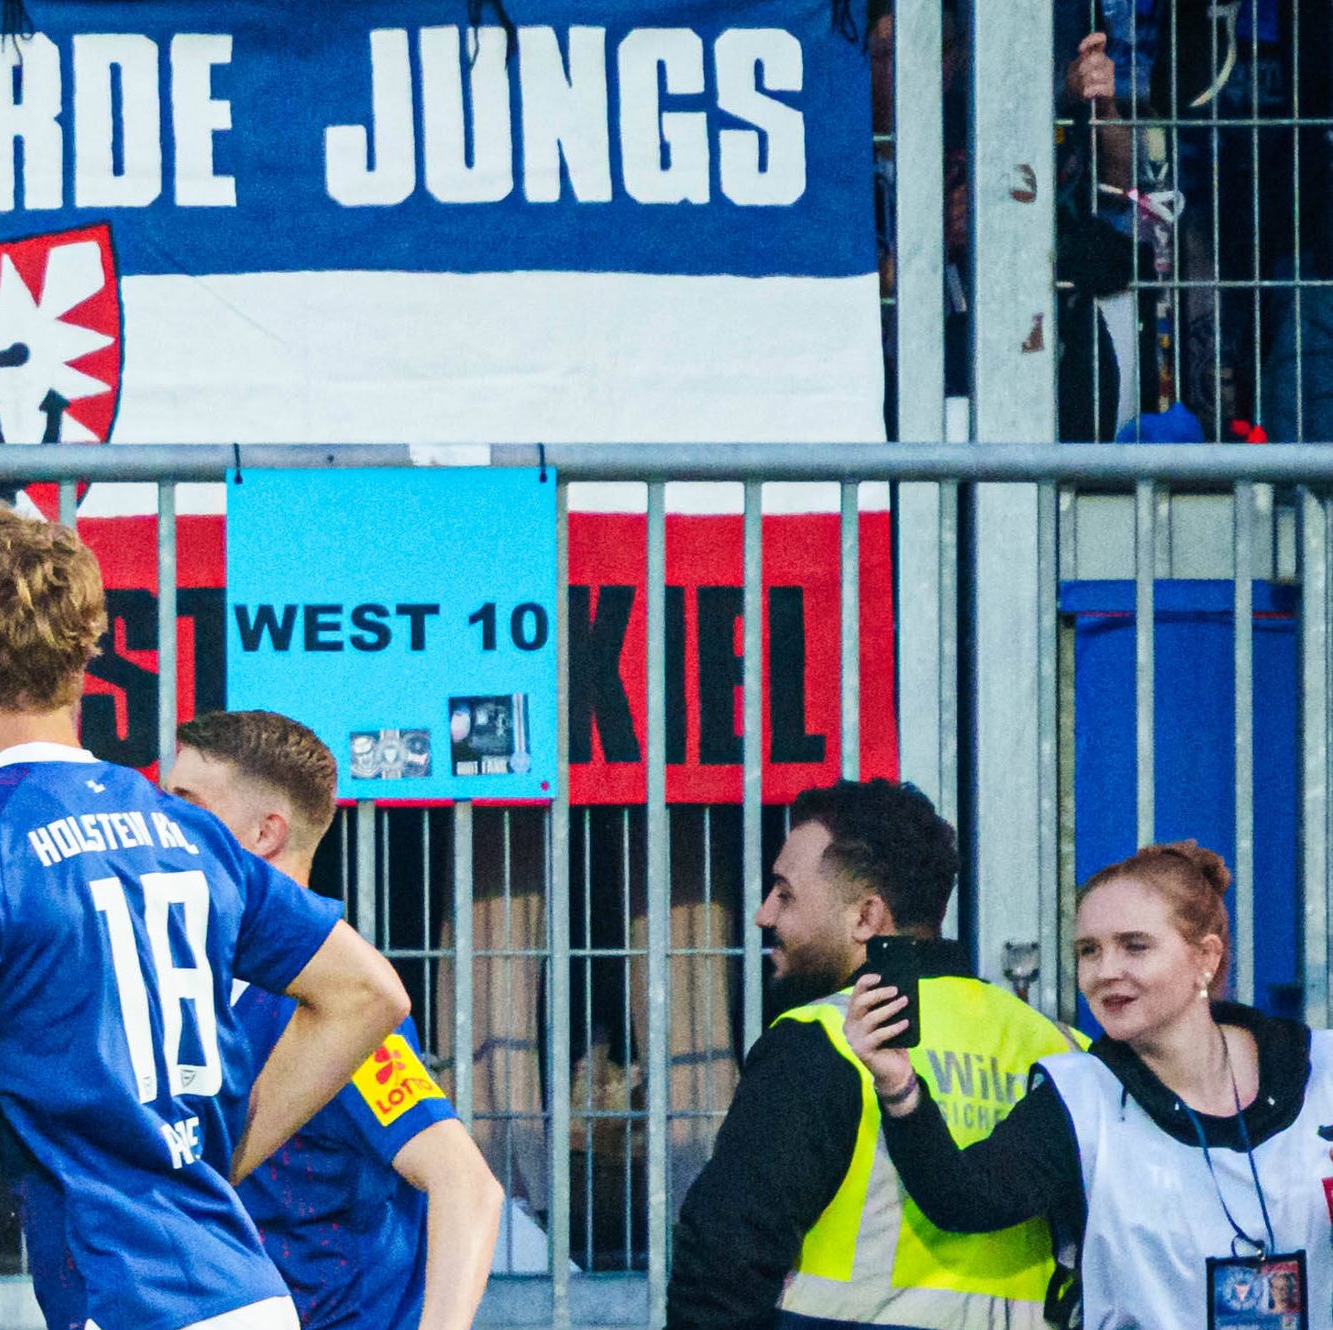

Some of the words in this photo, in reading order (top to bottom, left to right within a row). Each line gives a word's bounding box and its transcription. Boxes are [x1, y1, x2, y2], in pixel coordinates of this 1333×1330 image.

[323, 25, 807, 207] JUNGS
[234, 603, 440, 652] WEST
[468, 602, 549, 652] 10
[568, 584, 826, 764] KIEL
[88, 870, 223, 1105] 18
